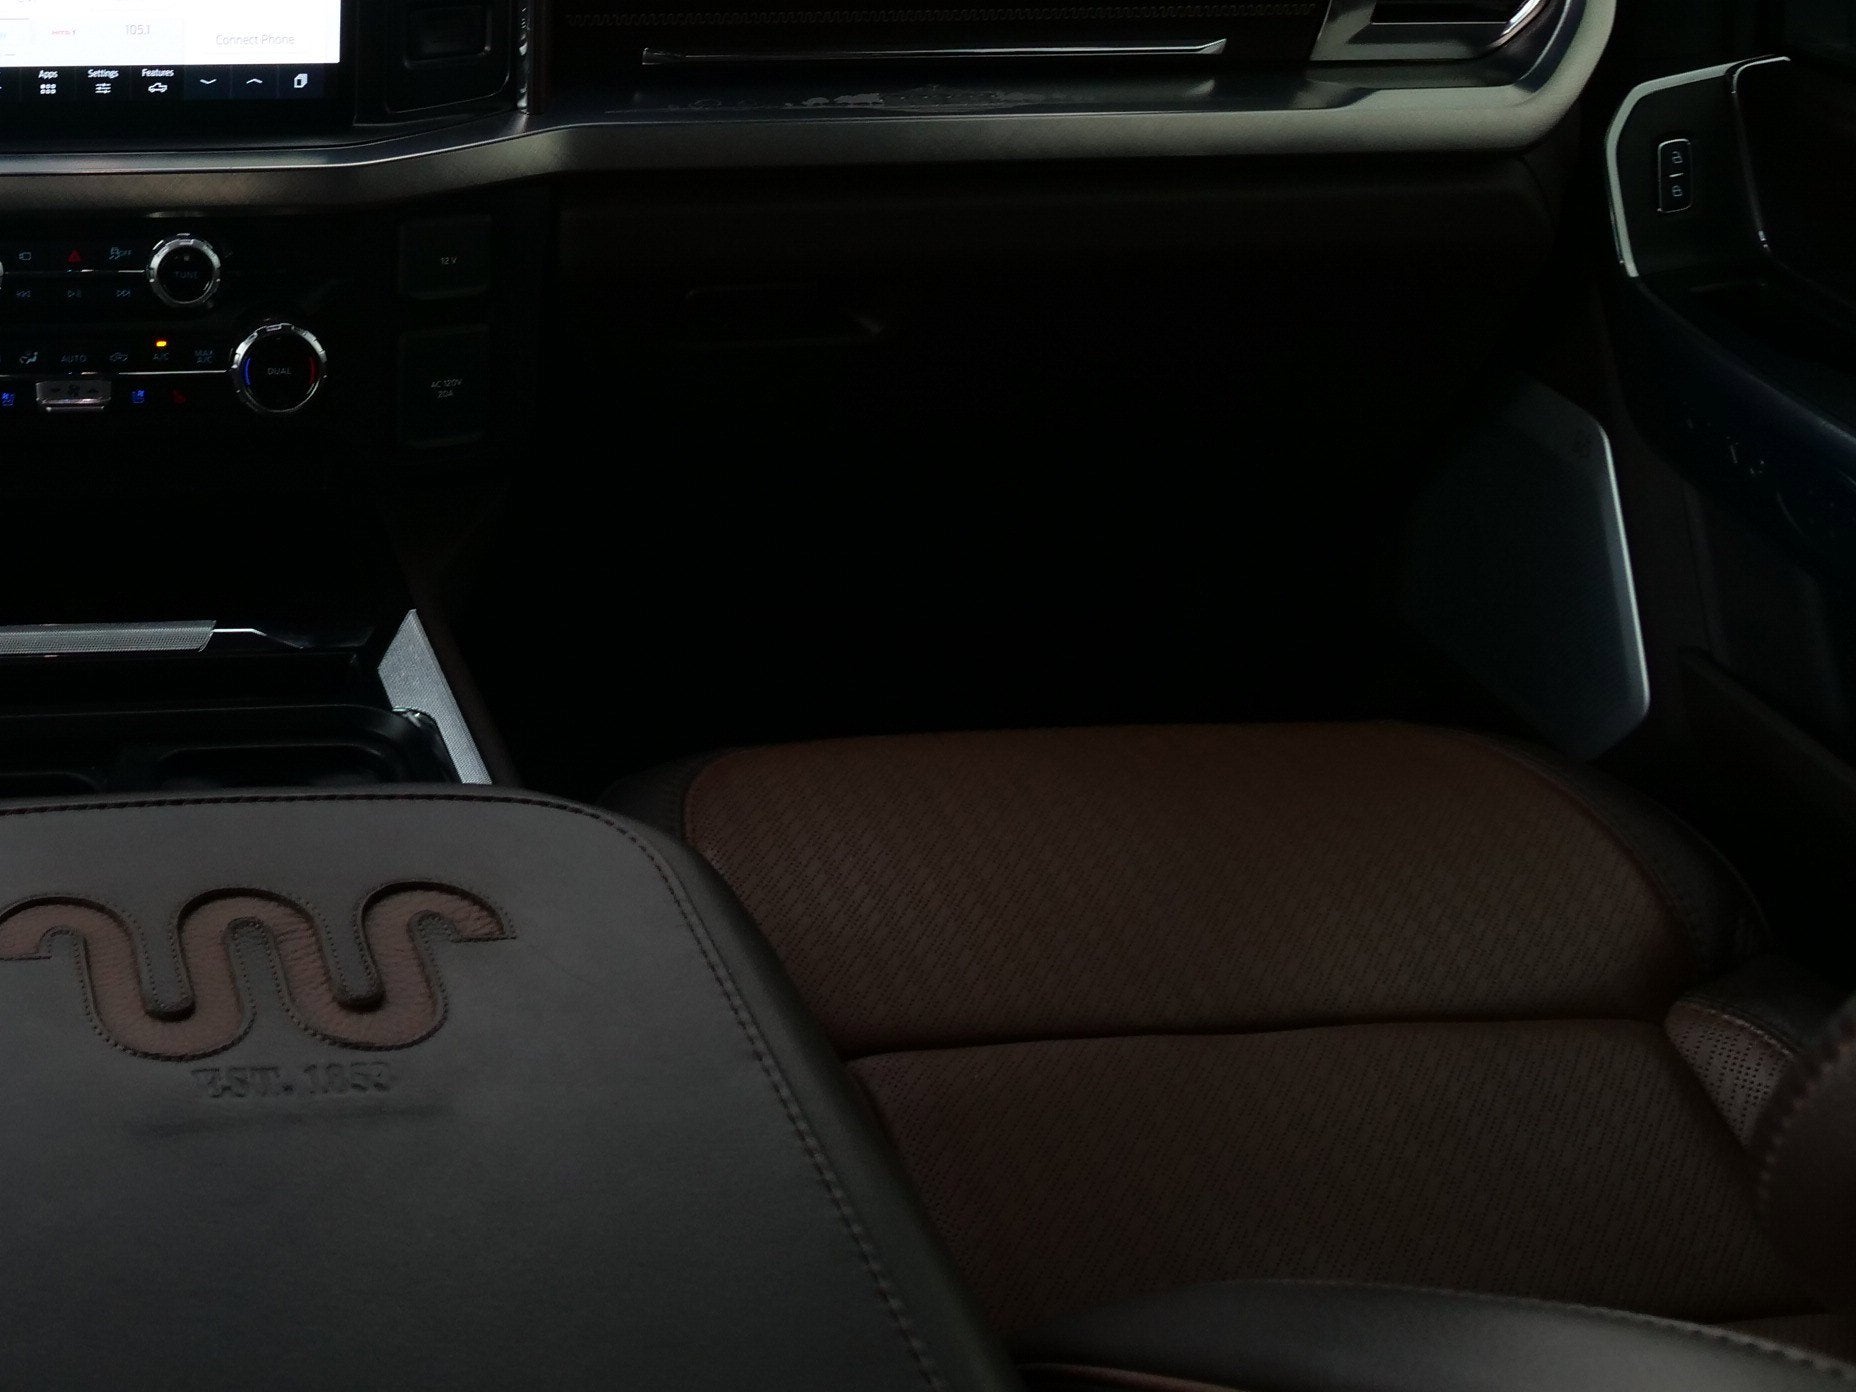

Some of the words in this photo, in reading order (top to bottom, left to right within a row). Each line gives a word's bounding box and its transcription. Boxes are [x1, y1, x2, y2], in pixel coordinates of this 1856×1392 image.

[39, 70, 58, 81] Apps
[88, 69, 119, 79] Settings
[142, 68, 174, 77] Features
[267, 367, 293, 376] DUAL
